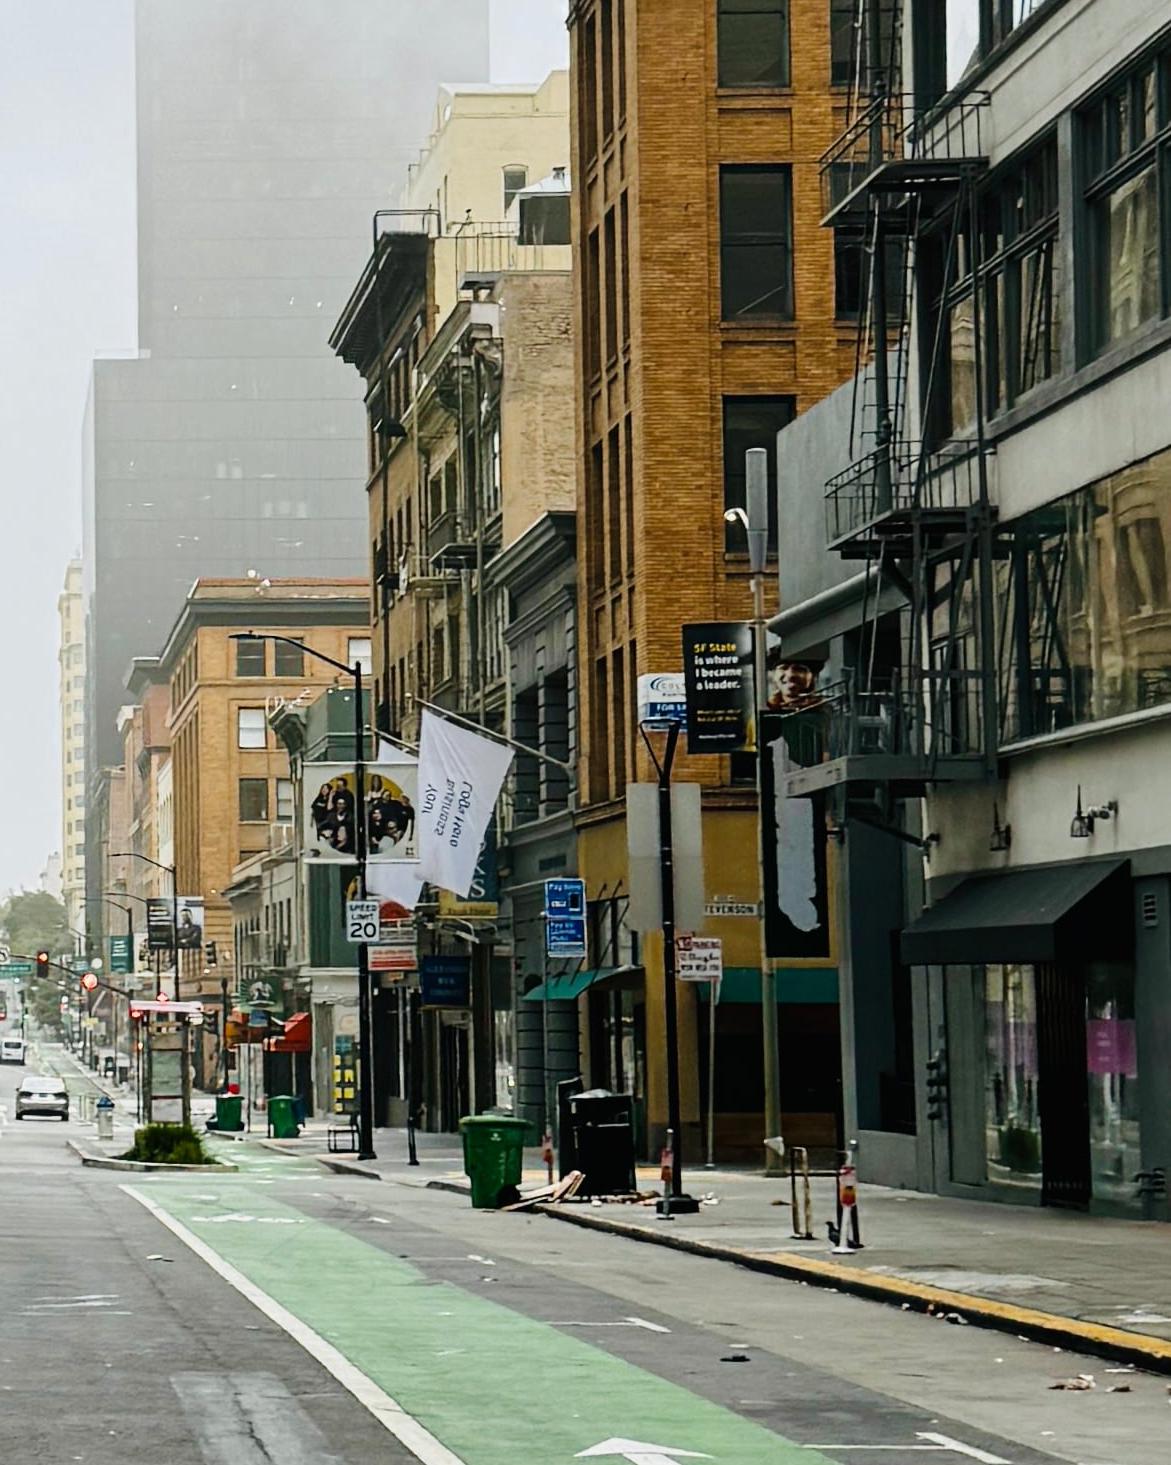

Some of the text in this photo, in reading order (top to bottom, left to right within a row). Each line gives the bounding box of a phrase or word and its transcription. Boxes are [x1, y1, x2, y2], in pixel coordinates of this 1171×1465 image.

[694, 643, 737, 653] SF State
[694, 655, 739, 665] is where
[701, 668, 742, 678] became
[696, 679, 741, 690] a leader.
[704, 905, 754, 914] TEVENSON
[350, 922, 377, 938] 20
